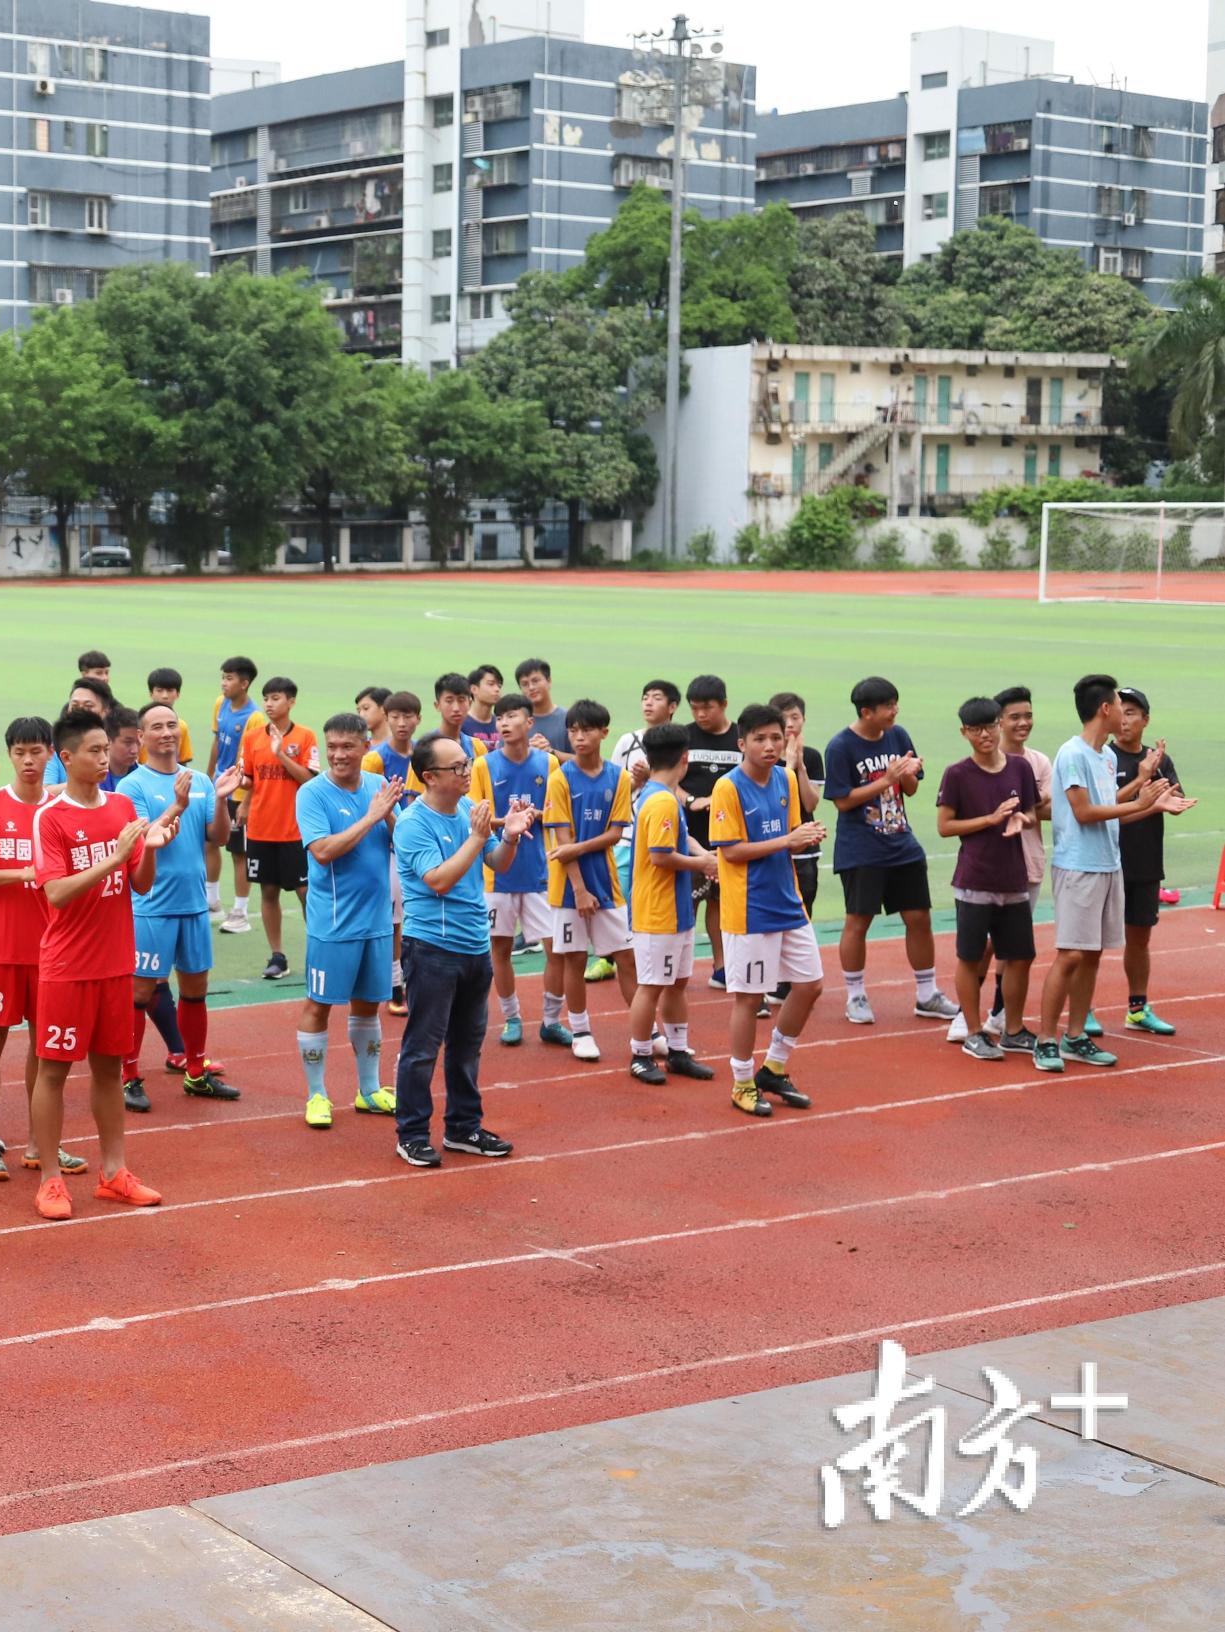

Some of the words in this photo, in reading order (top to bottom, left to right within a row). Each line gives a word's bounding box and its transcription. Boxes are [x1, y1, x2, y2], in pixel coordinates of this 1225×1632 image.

[762, 819, 782, 834] 元朗
[70, 838, 118, 871] 翠园中
[101, 870, 124, 897] 25
[563, 922, 573, 943] 6
[663, 955, 673, 977] 5
[746, 960, 764, 984] 17
[311, 967, 326, 996] 11
[45, 1025, 77, 1050] 25
